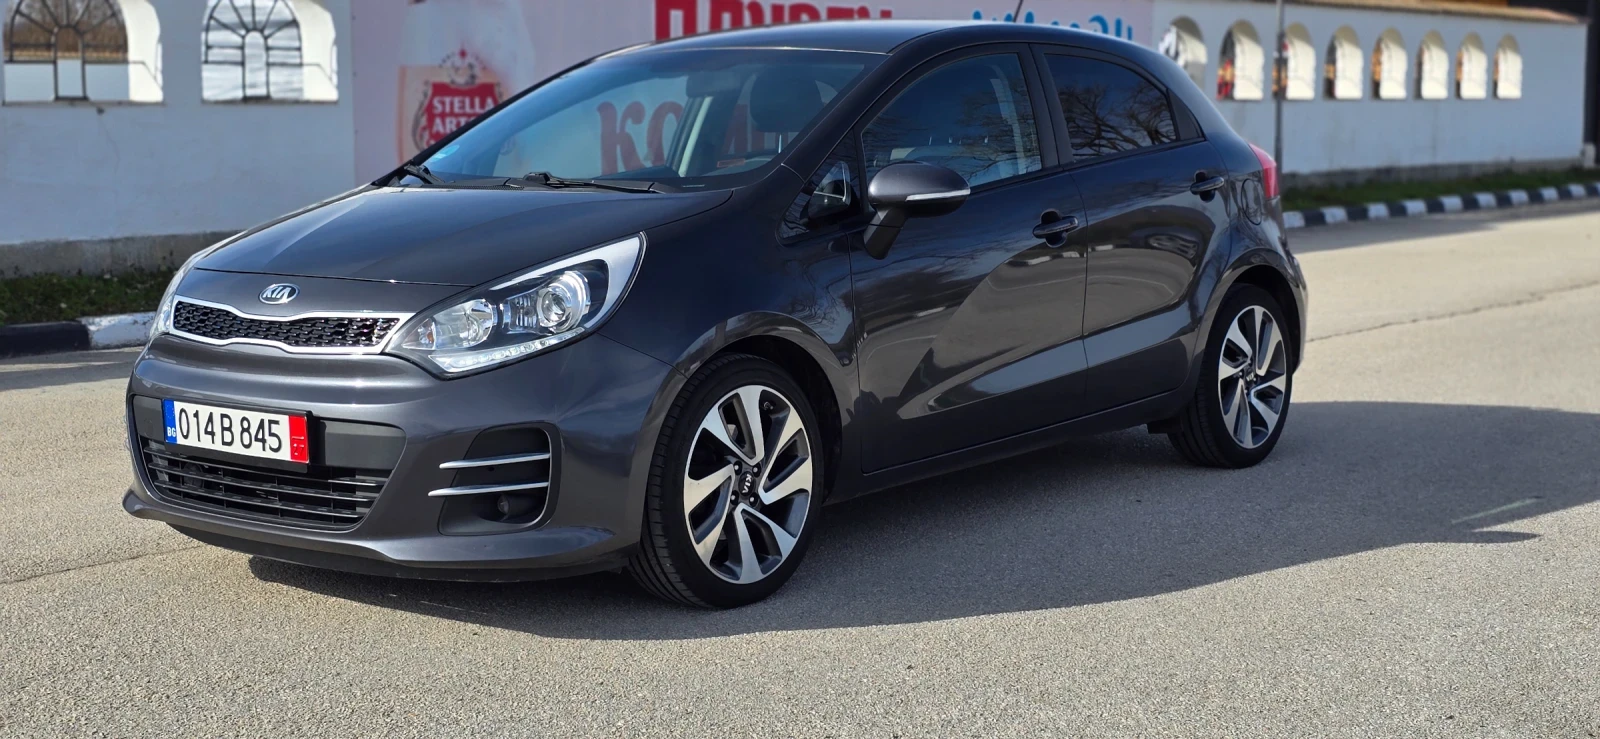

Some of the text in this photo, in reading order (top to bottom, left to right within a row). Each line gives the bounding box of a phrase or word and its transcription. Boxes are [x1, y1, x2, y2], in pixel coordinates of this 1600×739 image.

[432, 96, 496, 114] STELLA
[432, 116, 475, 135] ART
[262, 286, 292, 302] KIA
[167, 426, 177, 437] BG
[742, 473, 752, 493] KIA
